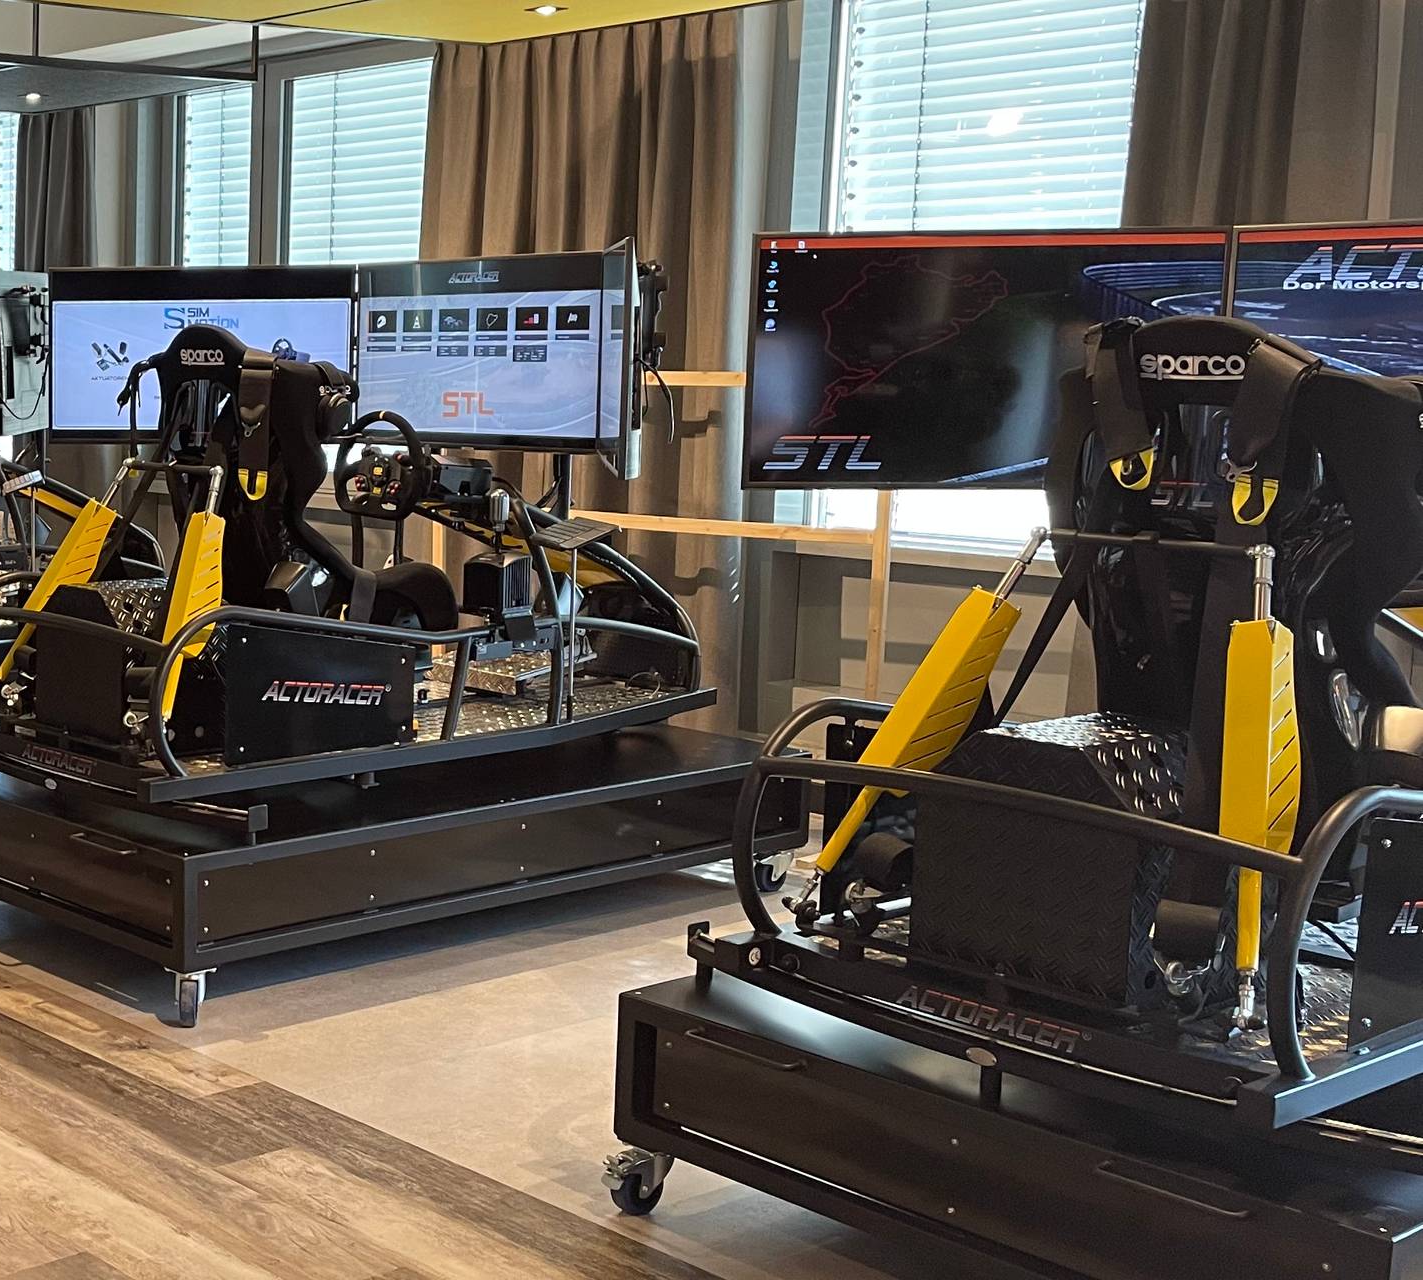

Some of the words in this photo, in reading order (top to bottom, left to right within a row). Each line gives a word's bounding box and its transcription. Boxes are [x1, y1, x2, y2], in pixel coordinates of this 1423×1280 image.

[1283, 245, 1423, 281] ACT
[1282, 280, 1325, 290] Der
[1332, 280, 1423, 290] Motors
[187, 307, 210, 318] SIM
[180, 348, 226, 366] sparco
[1139, 353, 1246, 381] sparco
[442, 391, 494, 417] STL
[762, 435, 882, 470] STL
